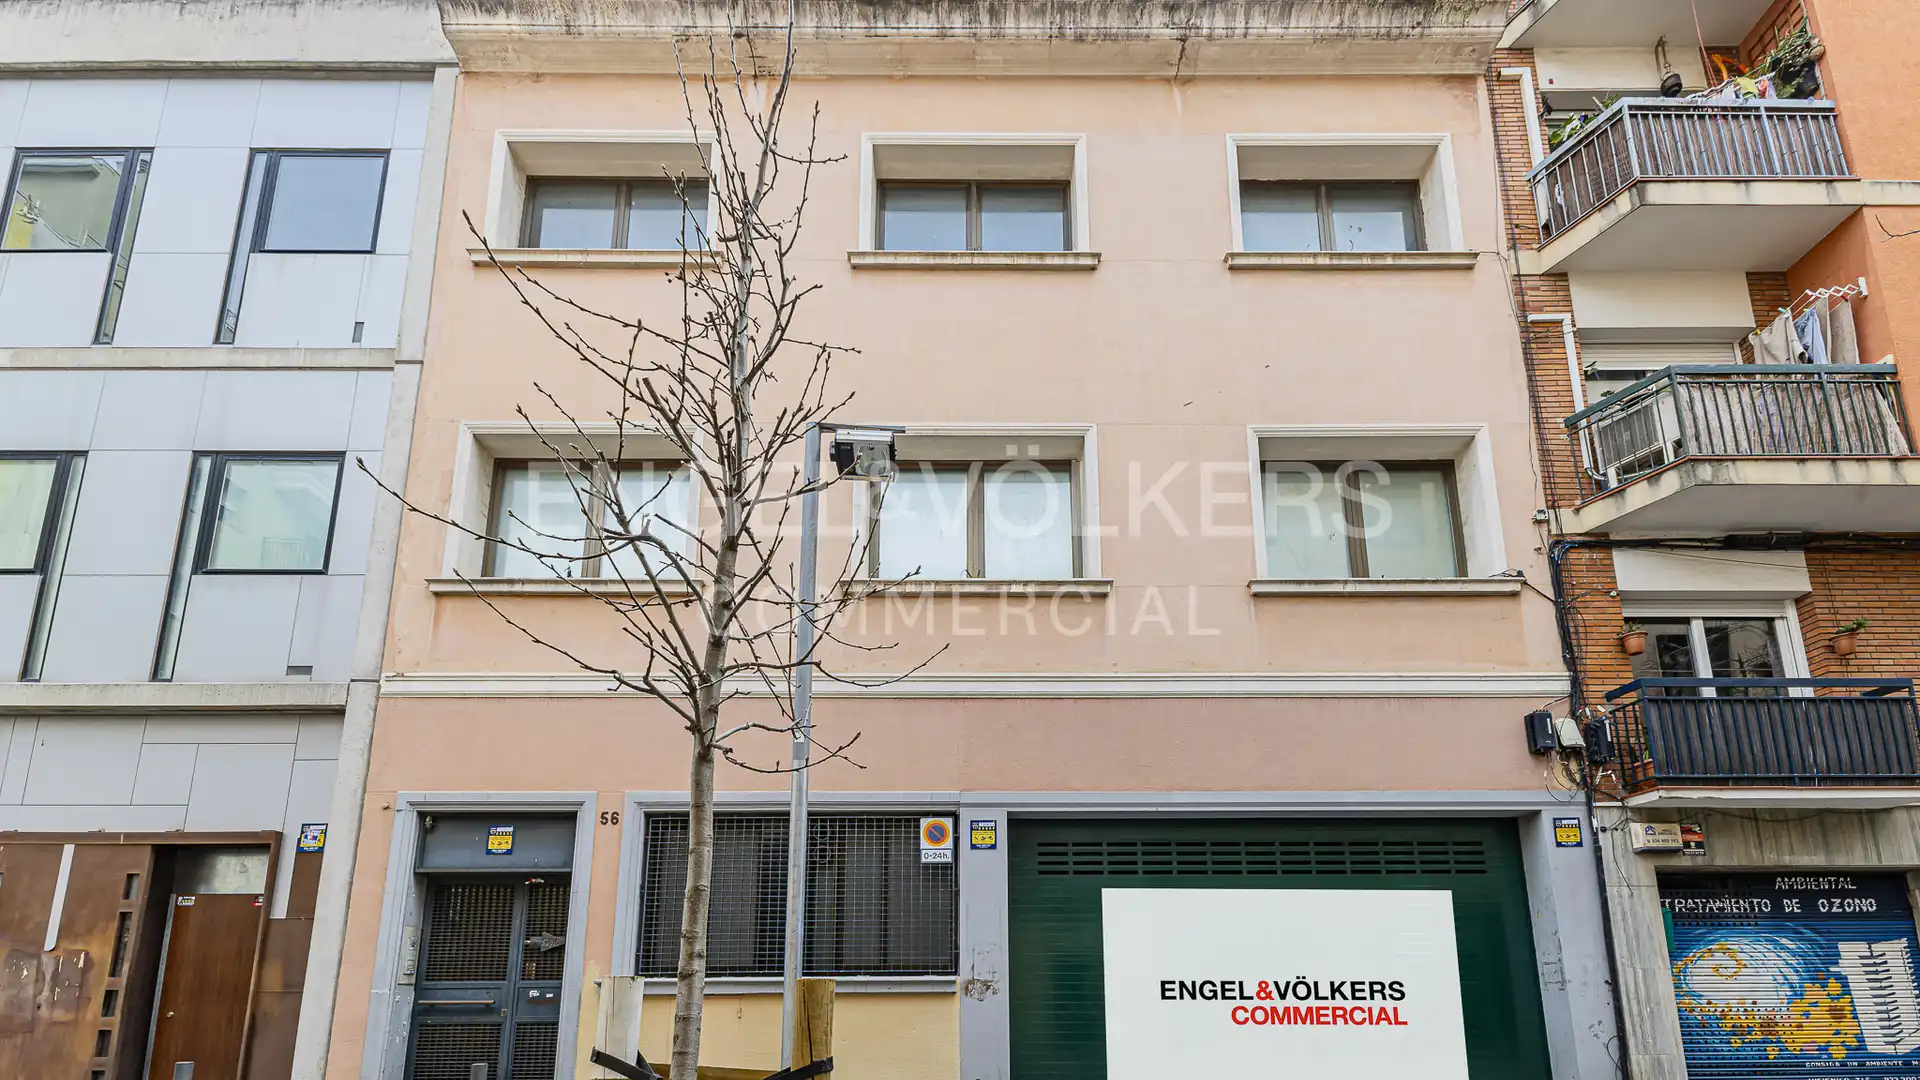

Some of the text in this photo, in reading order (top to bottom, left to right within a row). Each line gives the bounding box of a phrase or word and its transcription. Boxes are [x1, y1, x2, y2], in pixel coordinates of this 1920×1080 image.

[600, 811, 620, 825] 56
[1775, 877, 1857, 890] AMBIENTAL
[1784, 899, 1802, 912] DE
[1818, 899, 1877, 913] OZONO
[1160, 976, 1406, 1001] ENGEL&VÖLKERS
[1231, 1005, 1408, 1026] COMMERCIAL
